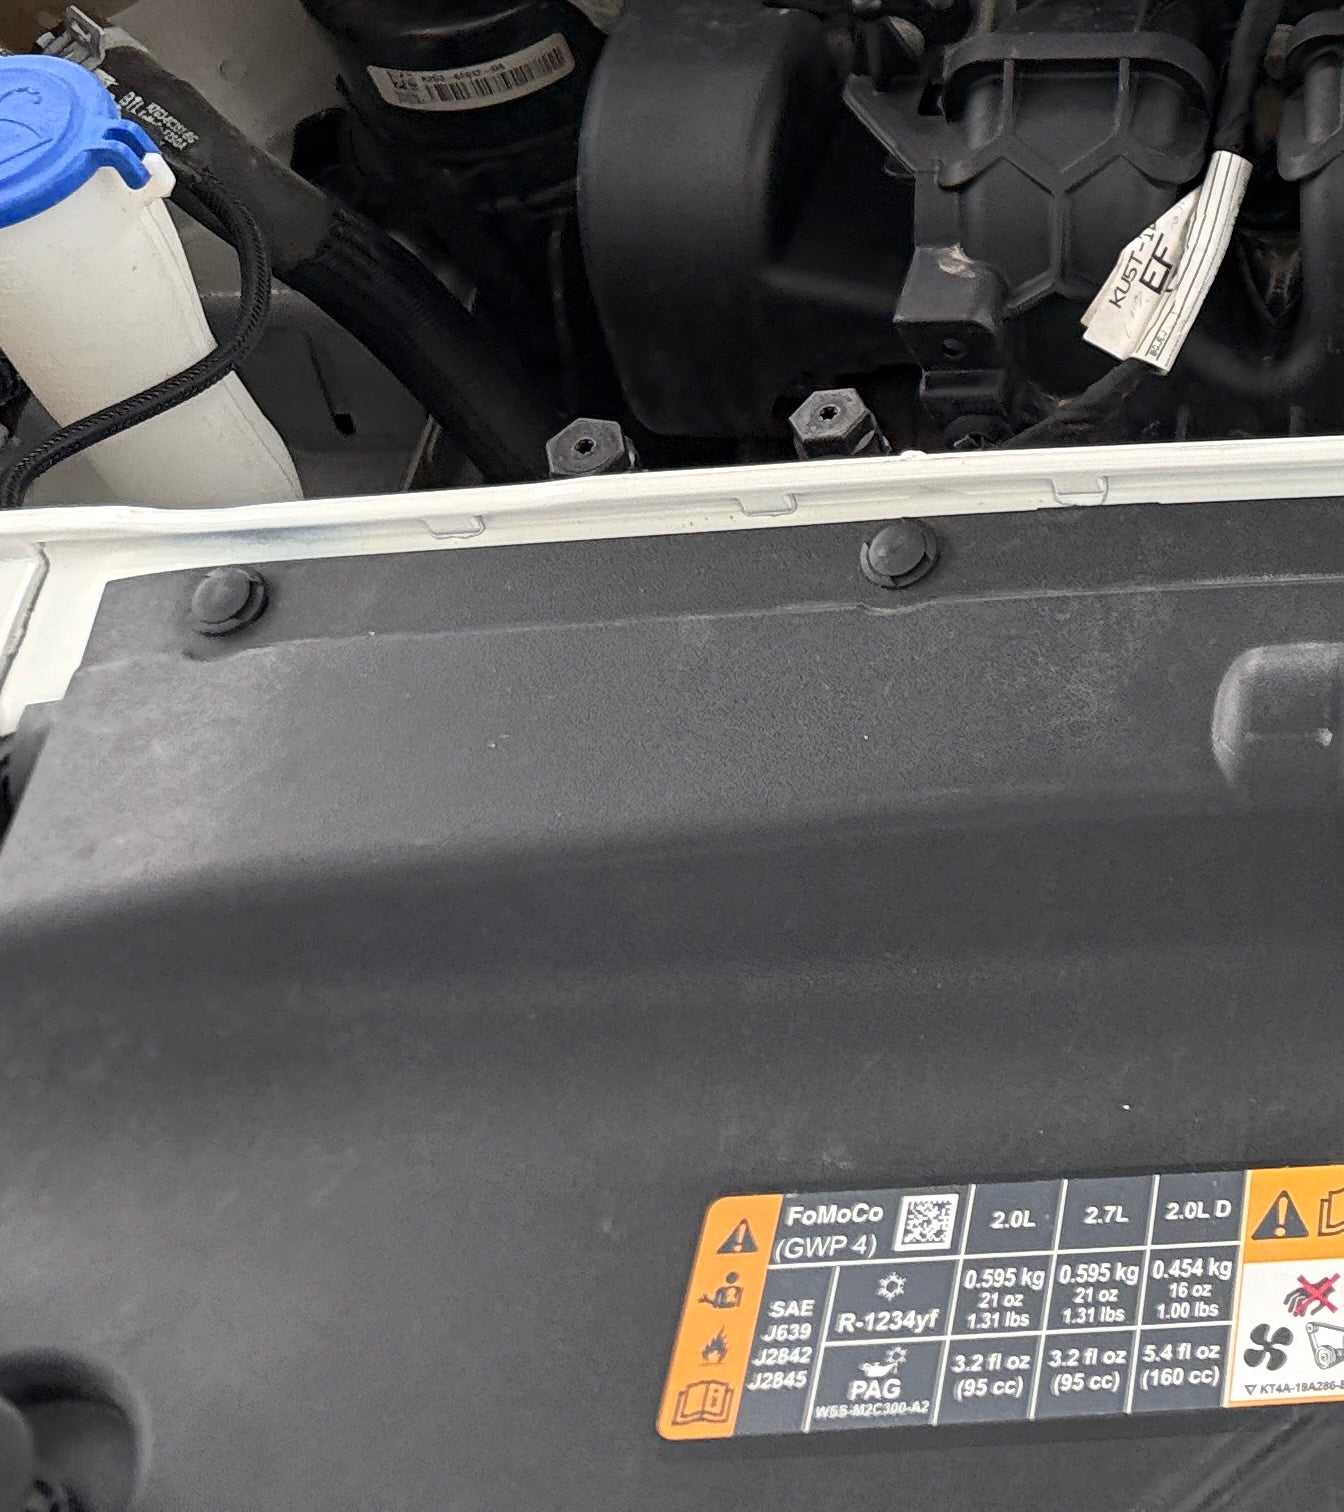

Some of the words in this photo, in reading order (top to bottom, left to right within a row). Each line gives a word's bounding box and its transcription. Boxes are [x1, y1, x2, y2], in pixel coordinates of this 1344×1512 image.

[1139, 232, 1173, 295] EF
[787, 1203, 883, 1226] FoMoCo
[990, 1209, 1036, 1229] 2.0L
[1083, 1205, 1129, 1224] 2.7L
[1165, 1201, 1210, 1220] 2.0L
[1214, 1200, 1232, 1218] D
[775, 1235, 847, 1263] (GWP
[852, 1234, 877, 1258] 4)
[964, 1268, 1016, 1289] 0.595
[1021, 1267, 1045, 1290] kg
[1059, 1263, 1111, 1284] 0.595
[1116, 1262, 1139, 1285] kg
[1152, 1258, 1203, 1279] 0.454
[1208, 1257, 1233, 1280] kg
[1073, 1287, 1093, 1304] 21
[1099, 1288, 1119, 1302] oz
[1169, 1282, 1187, 1298] 16
[1192, 1283, 1212, 1297] oz
[768, 1299, 815, 1318] SAE
[978, 1292, 998, 1309] 21
[1004, 1294, 1024, 1308] oz
[1157, 1302, 1189, 1320] 1.00
[1195, 1301, 1219, 1318] lbs
[836, 1308, 940, 1333] R-1234yf
[967, 1311, 999, 1329] 1.31
[1005, 1311, 1030, 1328] lbs
[1063, 1307, 1095, 1324] 1.31
[1100, 1306, 1125, 1323] lbs
[762, 1323, 812, 1342] J639
[752, 1346, 813, 1366] J2842
[952, 1355, 984, 1373] 3.2
[988, 1352, 1001, 1371] fl
[1007, 1355, 1031, 1370] oz
[1048, 1349, 1079, 1368] 3.2
[1084, 1348, 1097, 1365] fl
[1103, 1349, 1127, 1364] oz
[1143, 1345, 1173, 1363] 5.4
[1178, 1343, 1191, 1360] fl
[1196, 1345, 1221, 1360] oz
[746, 1370, 808, 1390] J2845
[1052, 1373, 1084, 1396] (95
[1089, 1371, 1121, 1393] cc)
[1141, 1369, 1184, 1391] (160
[1188, 1366, 1220, 1386] cc)
[847, 1378, 901, 1400] PAG
[955, 1378, 988, 1402] (95
[993, 1376, 1024, 1398] cc)
